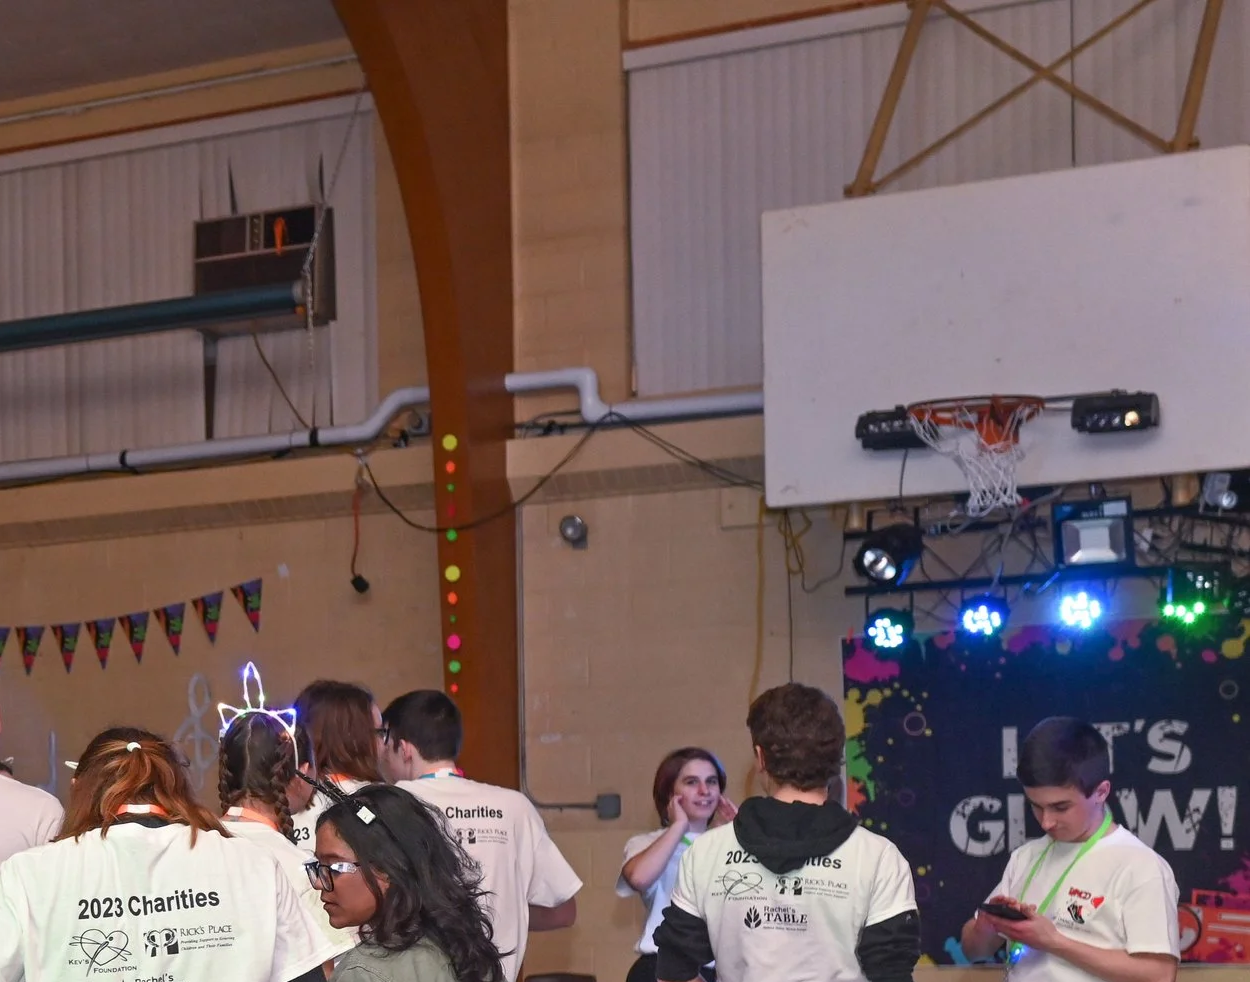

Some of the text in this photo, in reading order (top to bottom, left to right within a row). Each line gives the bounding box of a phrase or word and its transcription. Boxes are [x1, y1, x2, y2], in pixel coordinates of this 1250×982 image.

[1002, 718, 1193, 779] LT'S
[445, 806, 503, 819] Charities
[949, 786, 1238, 857] GLW!
[293, 827, 310, 841] 23
[78, 888, 220, 920] 2023 Charities
[763, 913, 808, 924] TABLE
[208, 925, 232, 935] PLACE
[93, 965, 138, 974] FOUNDATION
